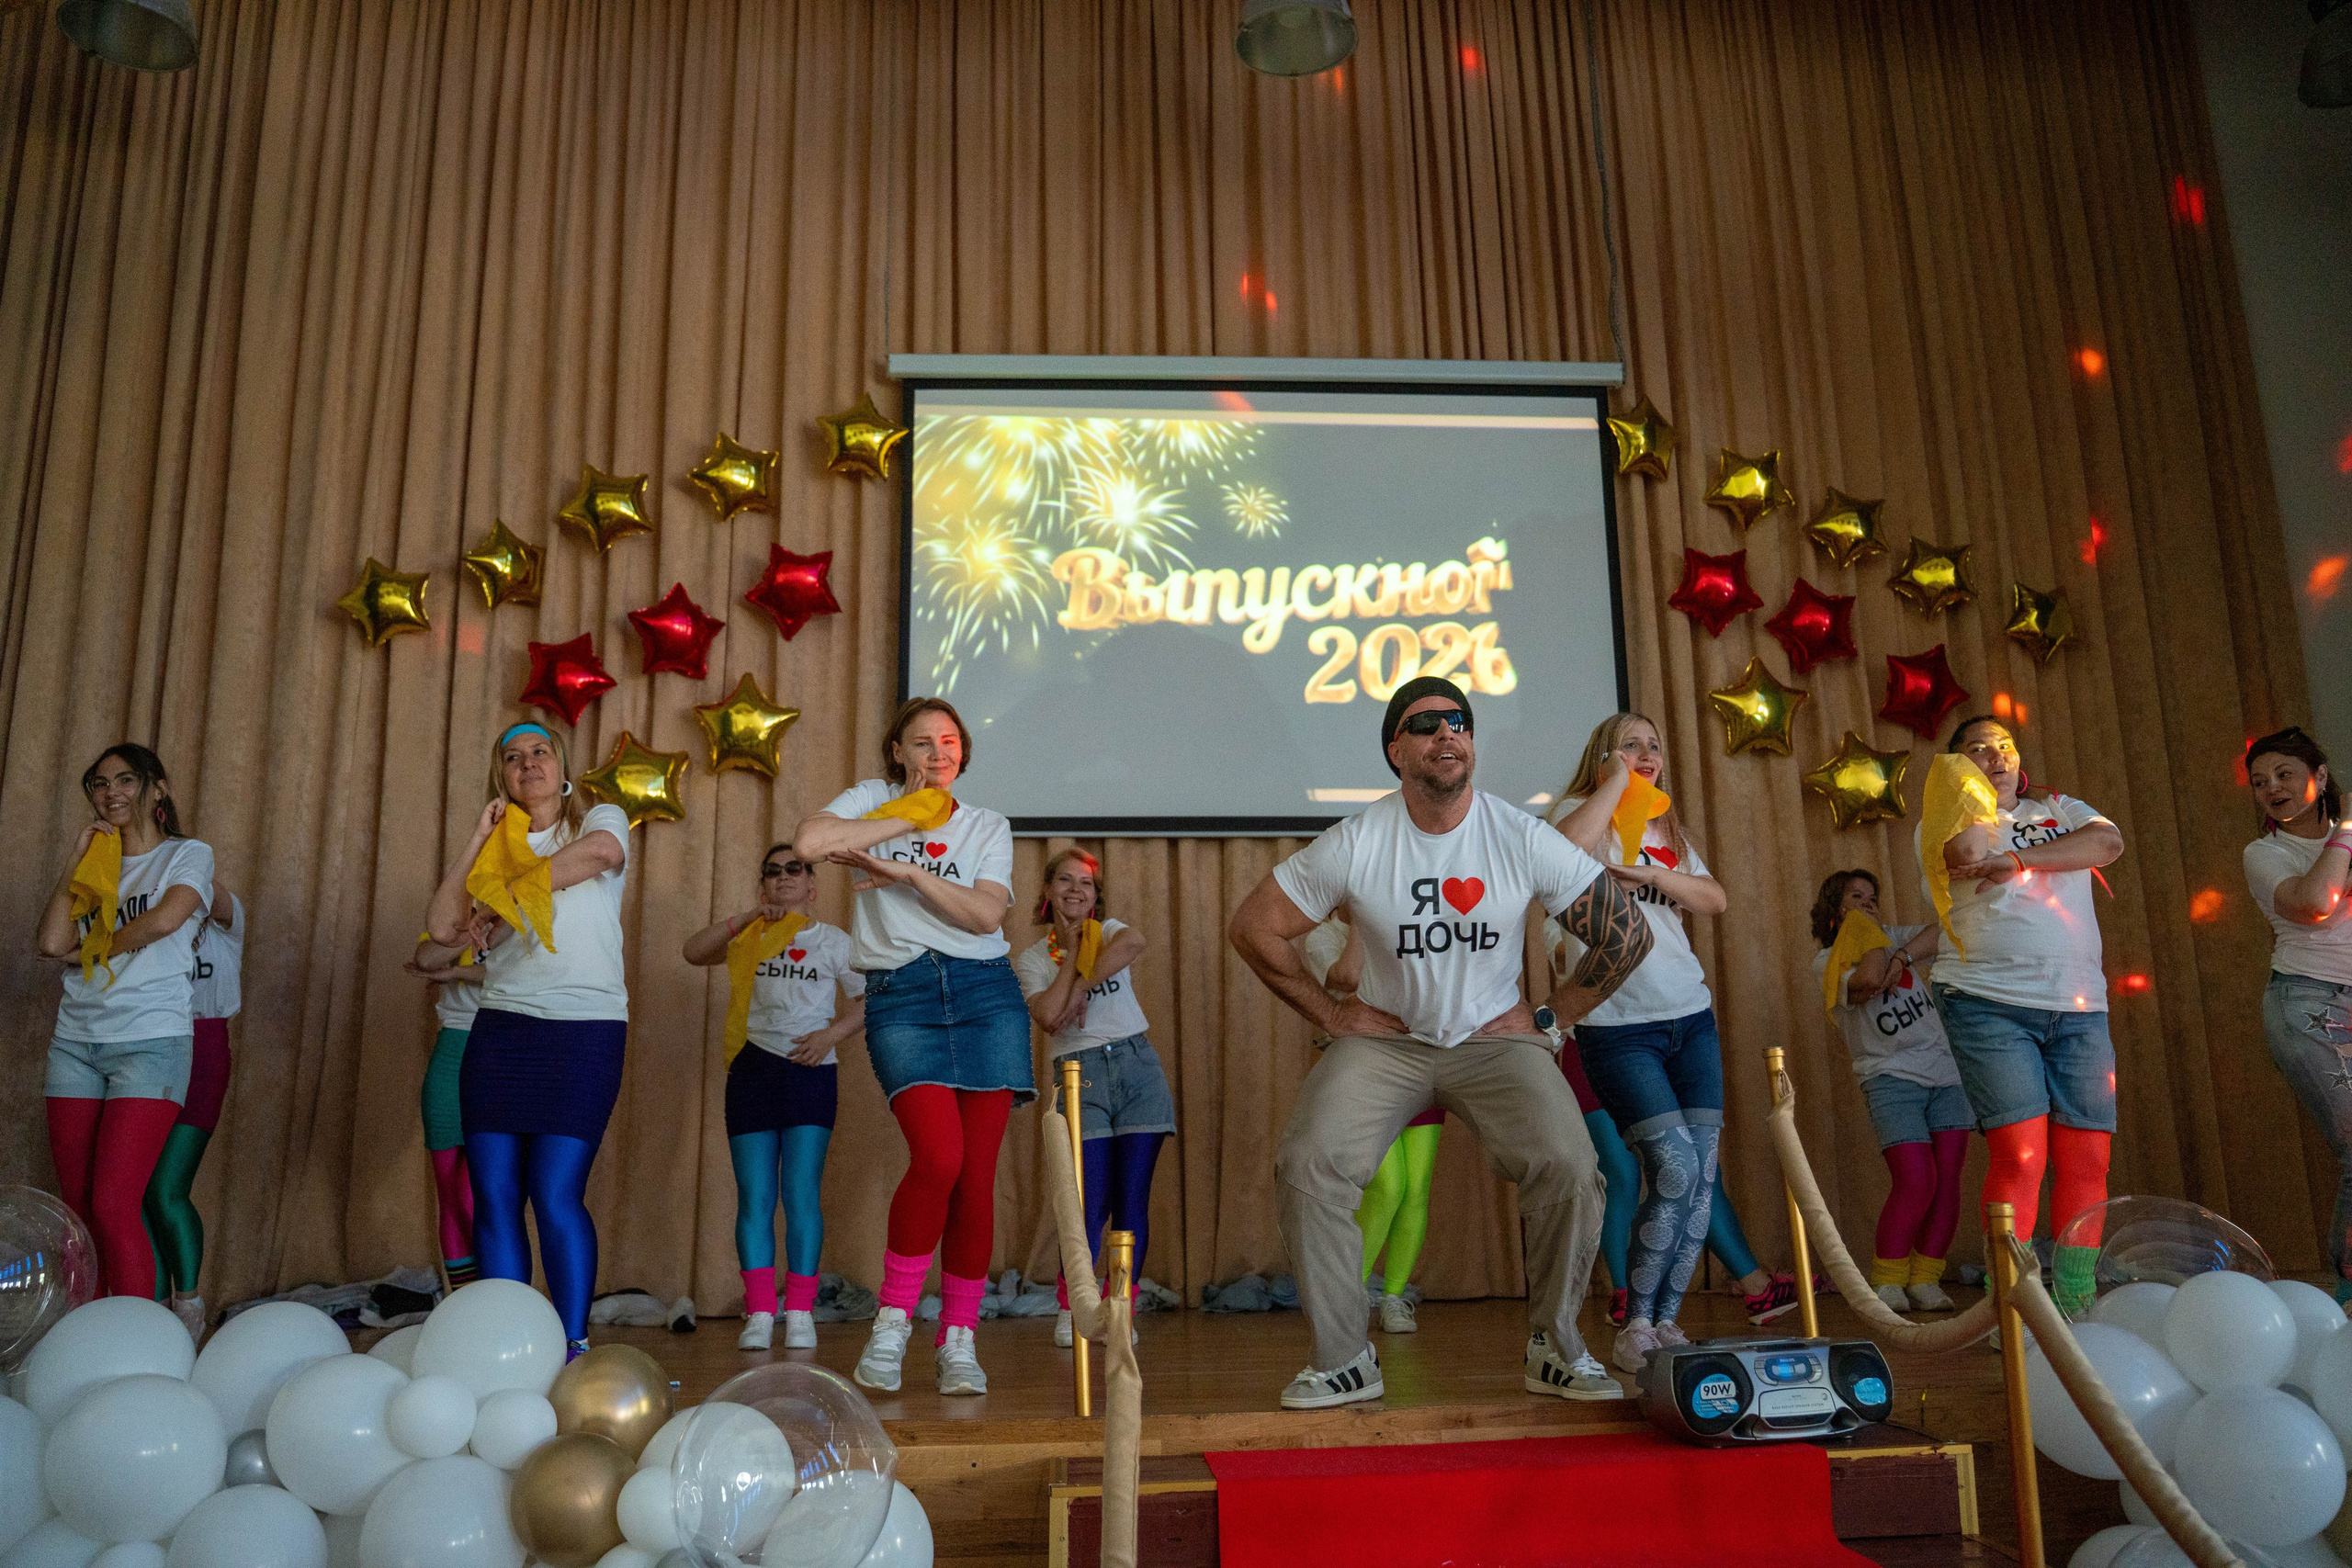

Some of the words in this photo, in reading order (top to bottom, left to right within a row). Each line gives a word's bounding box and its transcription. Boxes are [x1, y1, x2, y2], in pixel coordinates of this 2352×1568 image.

[1051, 536, 1514, 654] Выпускной
[1304, 621, 1518, 704] 2026
[1410, 877, 1441, 917] Я
[1396, 920, 1500, 960] ДОЧЬ
[754, 961, 819, 983] СЫНА
[1702, 1382, 1732, 1396] 90W
